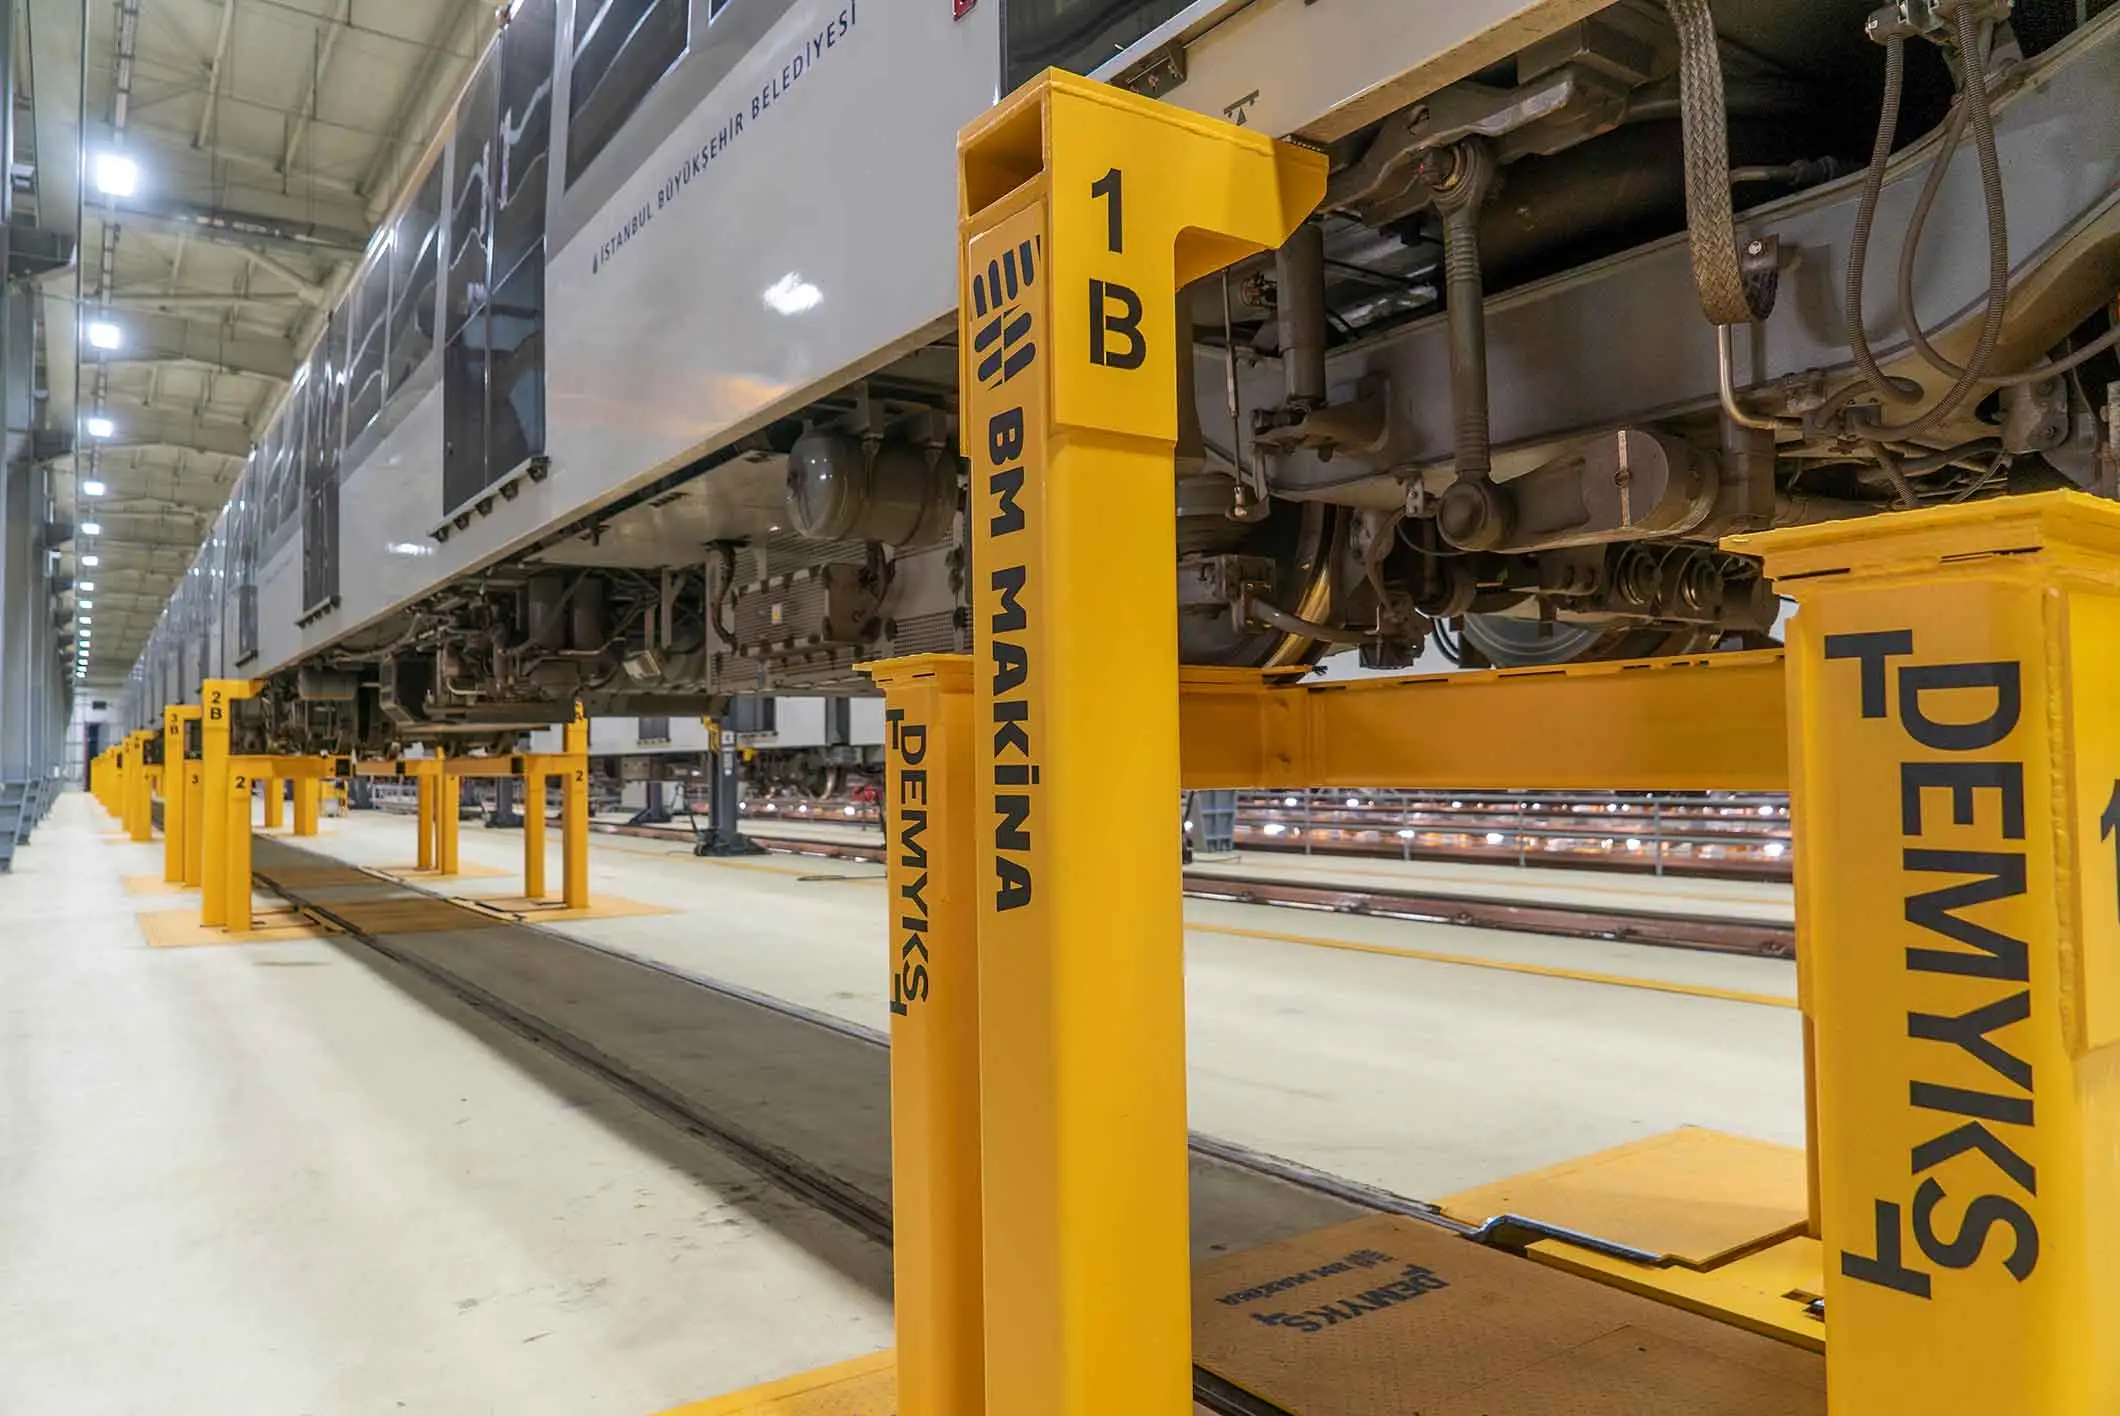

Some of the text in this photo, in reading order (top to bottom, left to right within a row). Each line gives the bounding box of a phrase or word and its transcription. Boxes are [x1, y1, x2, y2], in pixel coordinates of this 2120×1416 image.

[1091, 167, 1122, 254] 1
[1089, 278, 1147, 370] B
[988, 406, 1040, 913] BM MAKİNA
[210, 706, 223, 720] B
[211, 690, 222, 705] 2
[235, 775, 246, 790] 2
